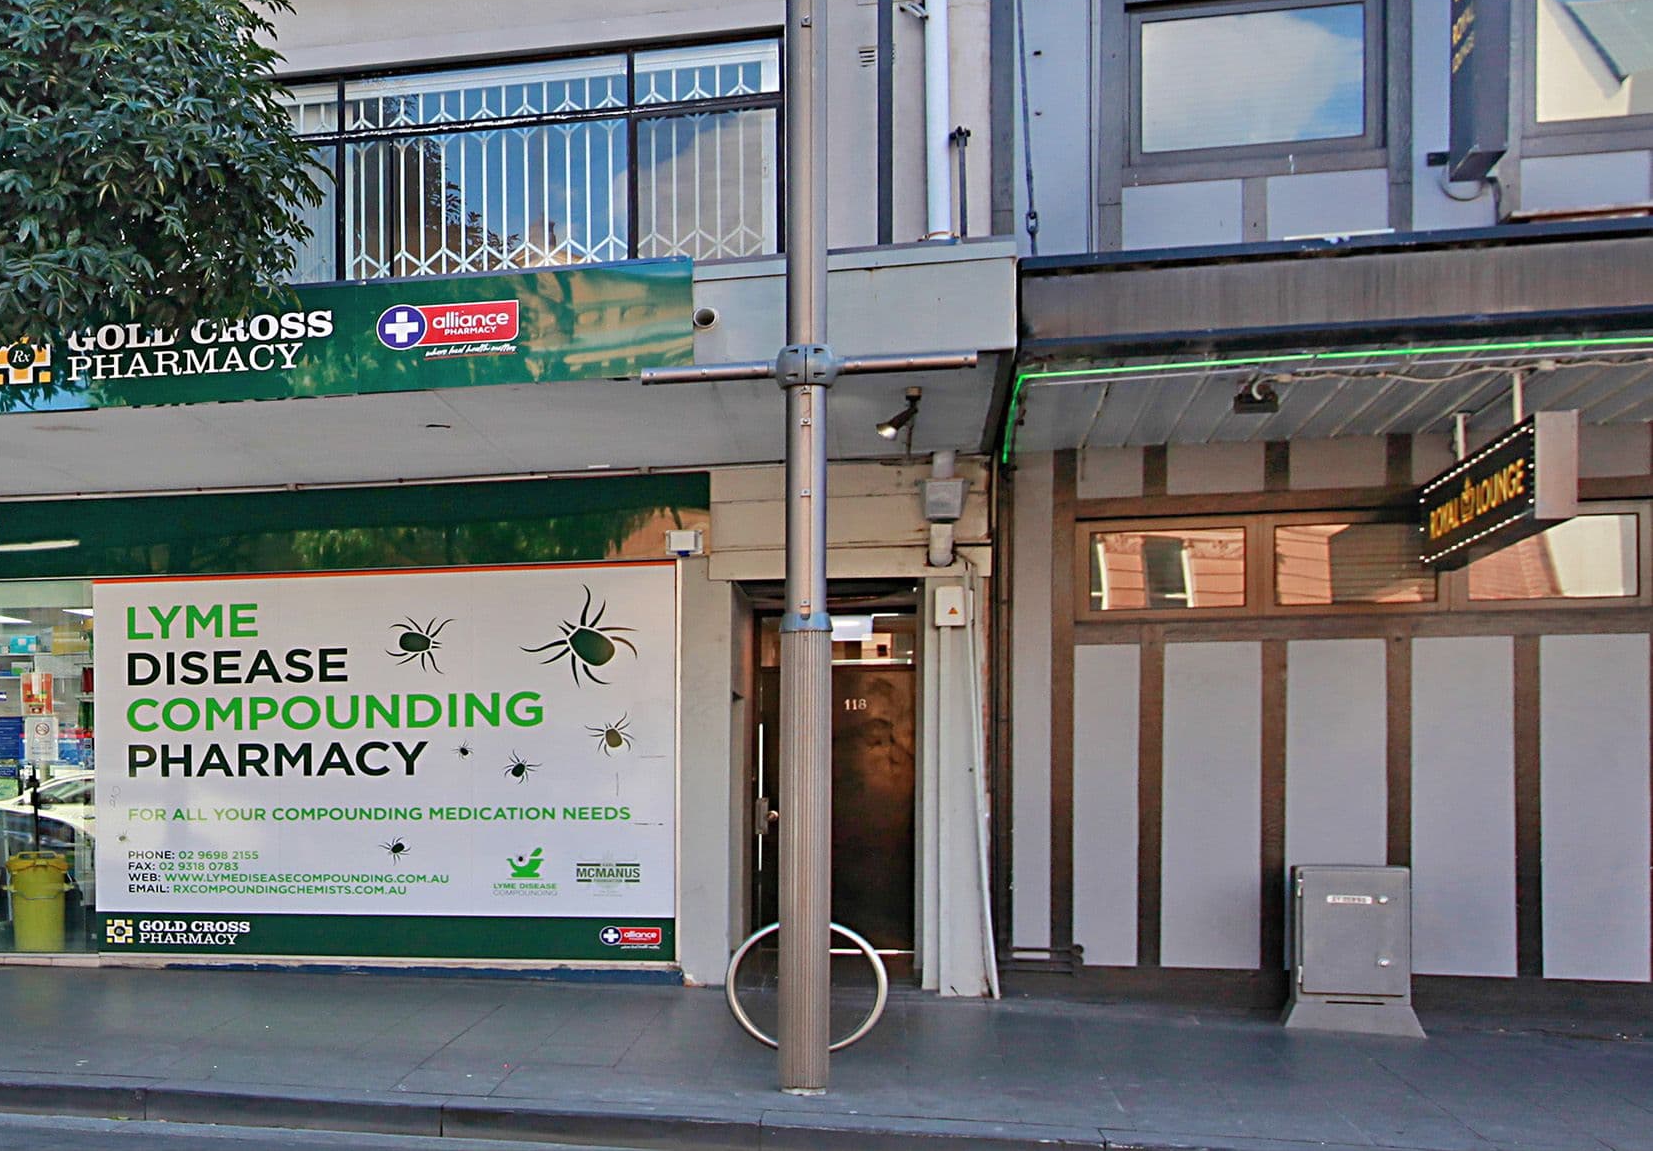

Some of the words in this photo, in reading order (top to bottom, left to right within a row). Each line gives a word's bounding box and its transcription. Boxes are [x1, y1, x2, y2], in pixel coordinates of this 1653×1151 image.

[432, 310, 510, 329] alliance
[67, 322, 179, 352] GOLD
[190, 310, 334, 345] CROSS
[444, 325, 497, 336] PHARMACY
[67, 342, 304, 381] PHARMACY
[1475, 458, 1526, 516] LOUNGE
[127, 603, 259, 640] LYME
[127, 647, 348, 686] DISEASE
[126, 691, 544, 732] COMPOUNDING
[844, 698, 867, 711] 118
[128, 741, 429, 778] PHARMACY
[128, 809, 166, 822] FOR
[172, 809, 207, 821] ALL
[212, 809, 266, 821] YOUR
[272, 808, 423, 821] COMPOUNDING
[429, 807, 556, 821] MEDICATION
[562, 807, 631, 820] NEEDS
[128, 850, 175, 860] PHONE:
[178, 850, 195, 859] 02
[197, 850, 229, 859] 9698
[232, 850, 259, 859] 2155
[128, 862, 155, 871] FAX:
[159, 862, 175, 871] 02
[178, 862, 205, 871] 9318
[209, 862, 239, 871] 0783
[576, 867, 641, 878] MCMANUS
[128, 873, 161, 882] WEB:
[164, 873, 450, 884] WWW.LYMEDISEASECOMPOUNDING.COM.AU
[128, 884, 170, 893] EMAIL:
[173, 884, 408, 895] RXCOMPOUNDINGCHEMISTS.COM.AU
[139, 920, 187, 933] GOLD
[191, 921, 251, 934] CROSS
[139, 932, 238, 945] PHARMACY
